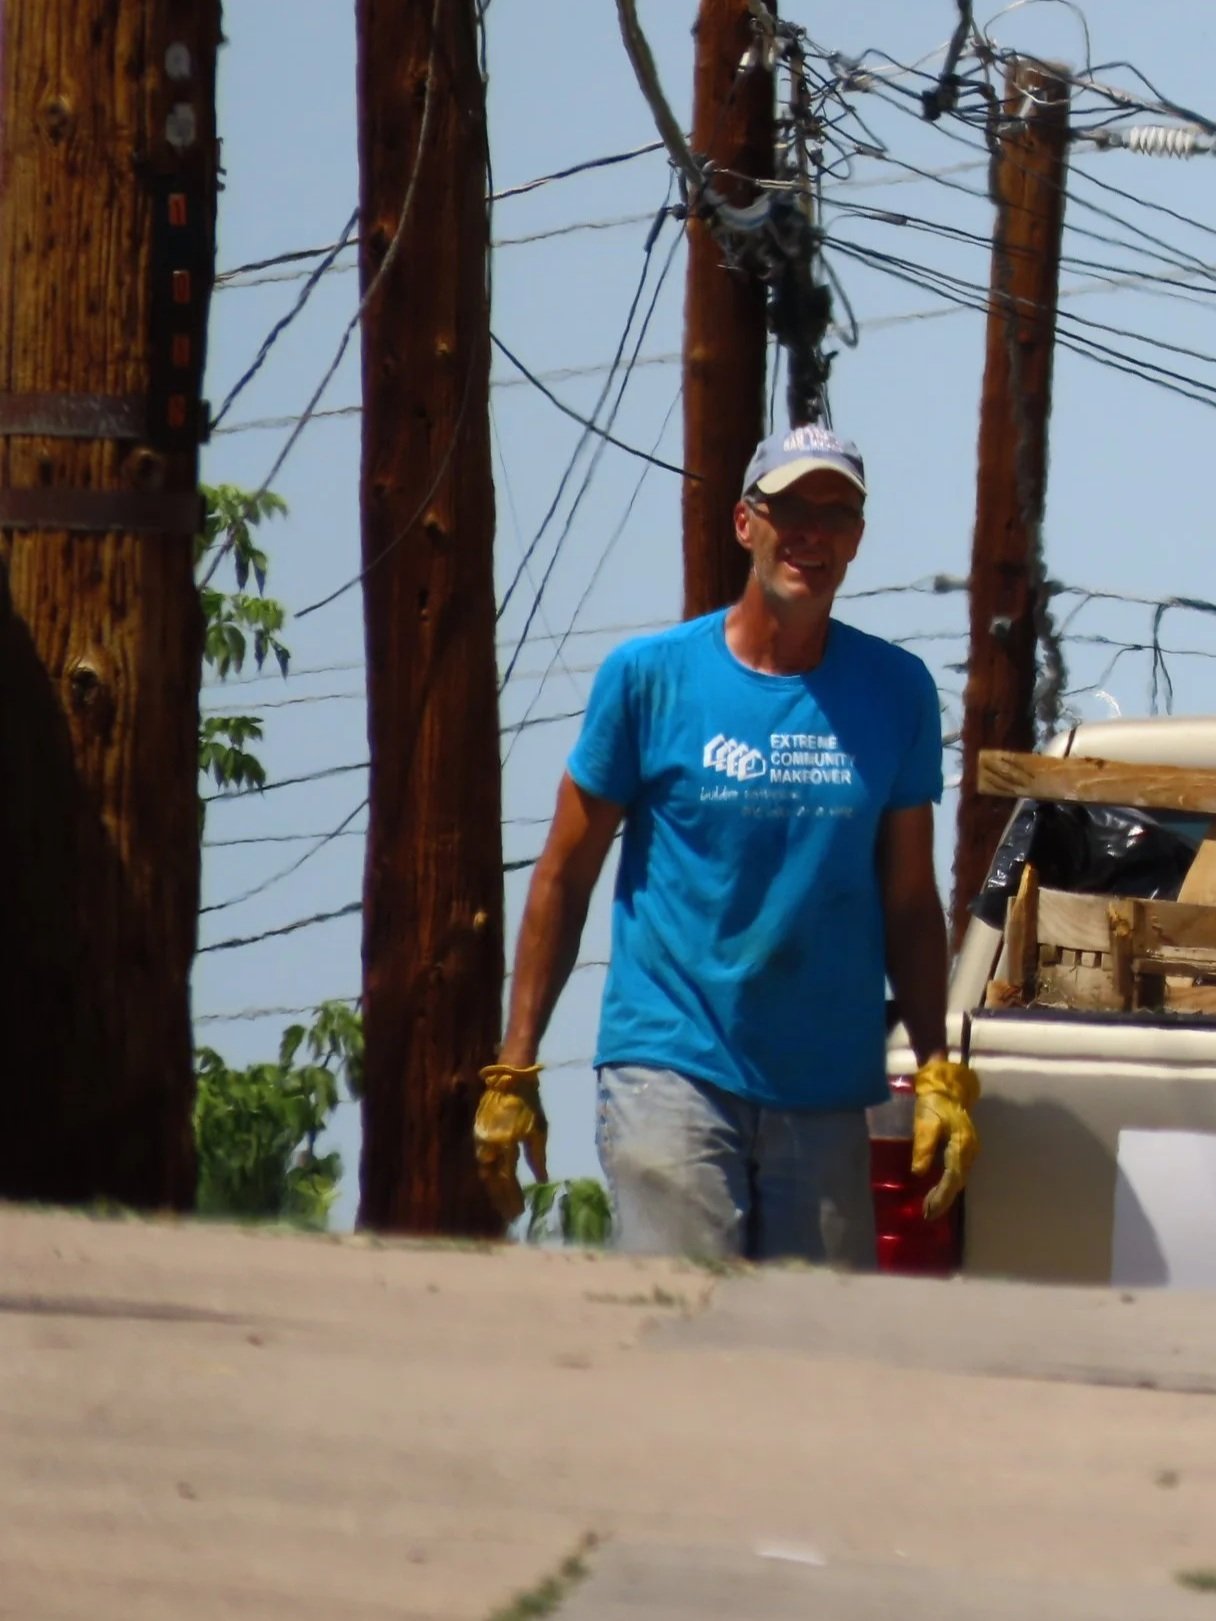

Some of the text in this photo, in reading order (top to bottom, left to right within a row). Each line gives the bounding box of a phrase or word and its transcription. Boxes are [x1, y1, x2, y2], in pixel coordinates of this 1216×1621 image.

[769, 734, 838, 750] EXTREME
[770, 751, 855, 768] COMMUNITY
[770, 768, 852, 785] MAKEOVER
